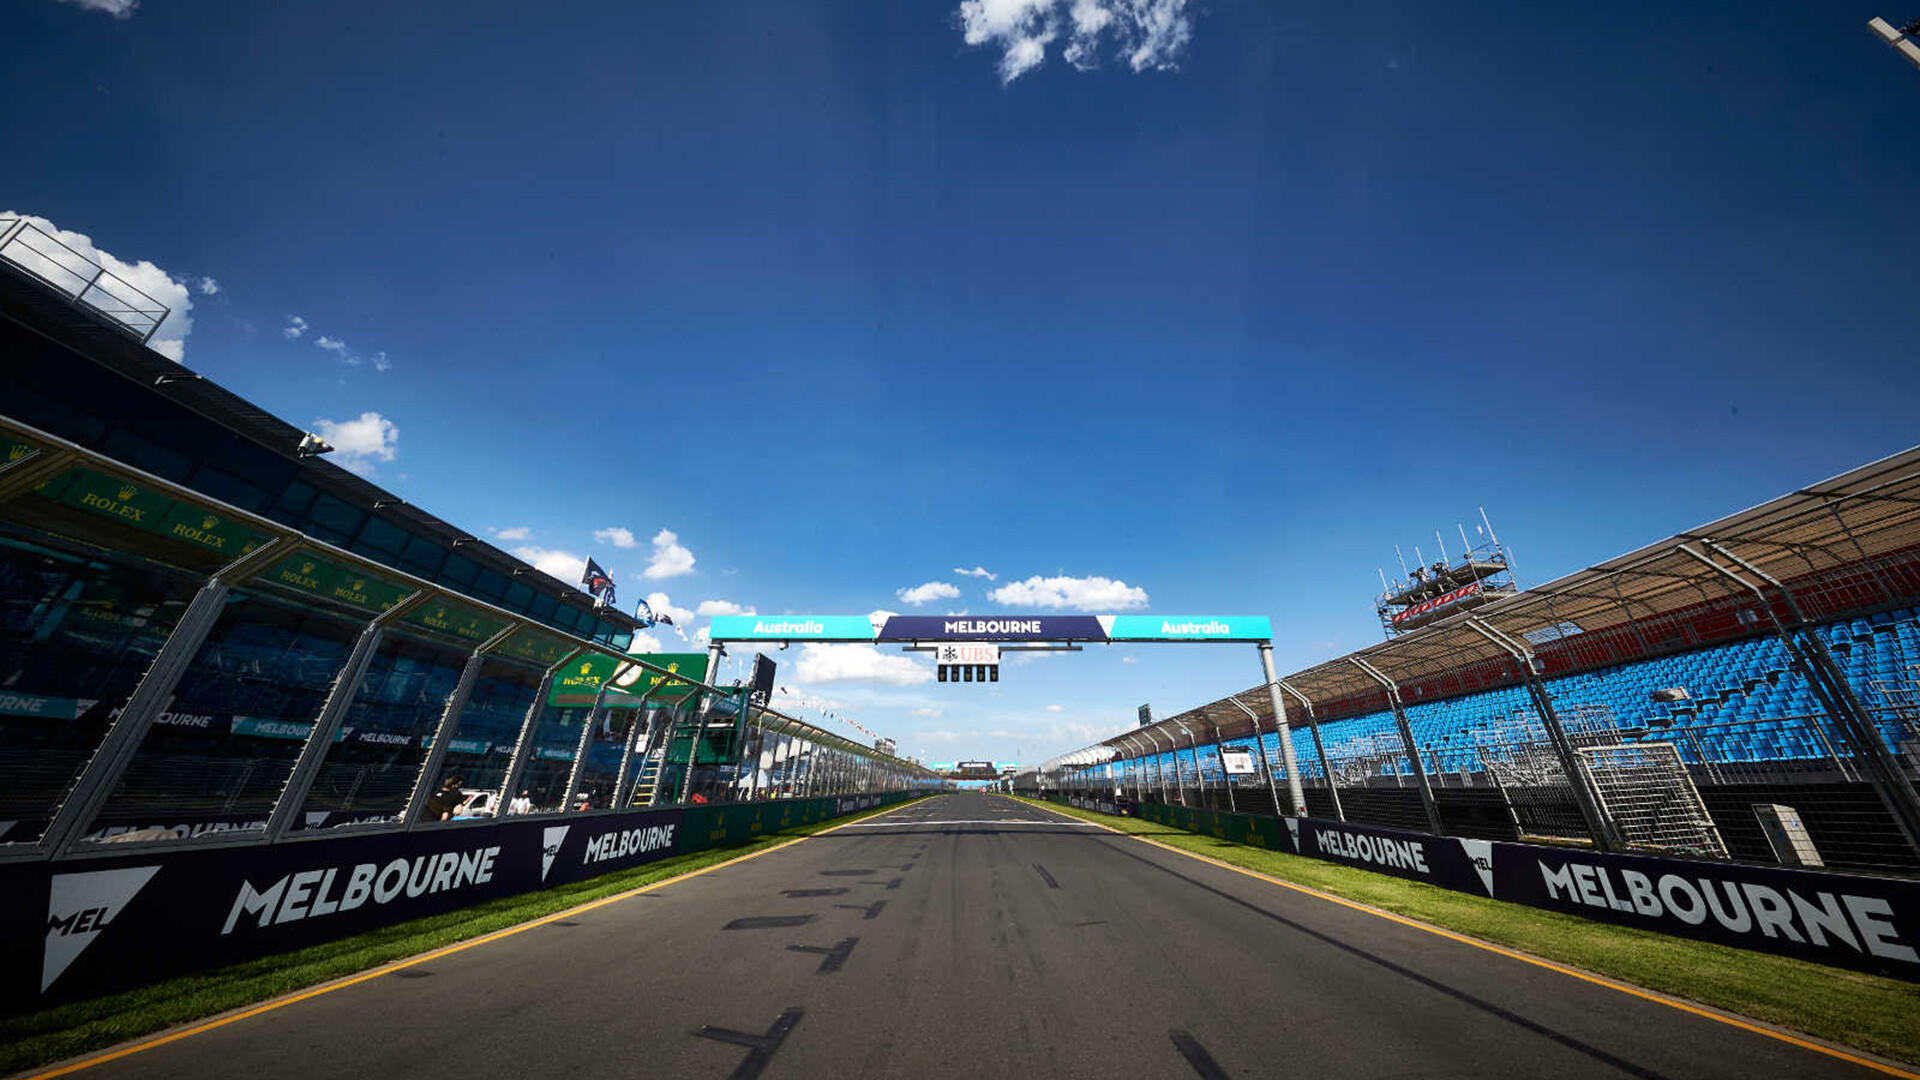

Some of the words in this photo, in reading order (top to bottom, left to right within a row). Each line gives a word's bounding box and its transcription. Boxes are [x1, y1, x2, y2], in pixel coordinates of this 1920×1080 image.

[82, 492, 146, 522] ROLEX
[172, 522, 227, 548] ROLEX
[753, 621, 824, 634] Australia
[944, 621, 1041, 634] MELBOURNE
[1161, 621, 1230, 634] Australia
[960, 647, 995, 661] UBS
[583, 823, 675, 865] MELBOURNE
[1315, 828, 1431, 874] MELBOURNE
[1467, 856, 1495, 872] MEL
[220, 846, 502, 935] MELBOURNE
[47, 907, 113, 937] MEL
[1538, 859, 1920, 964] MELBOURNE
